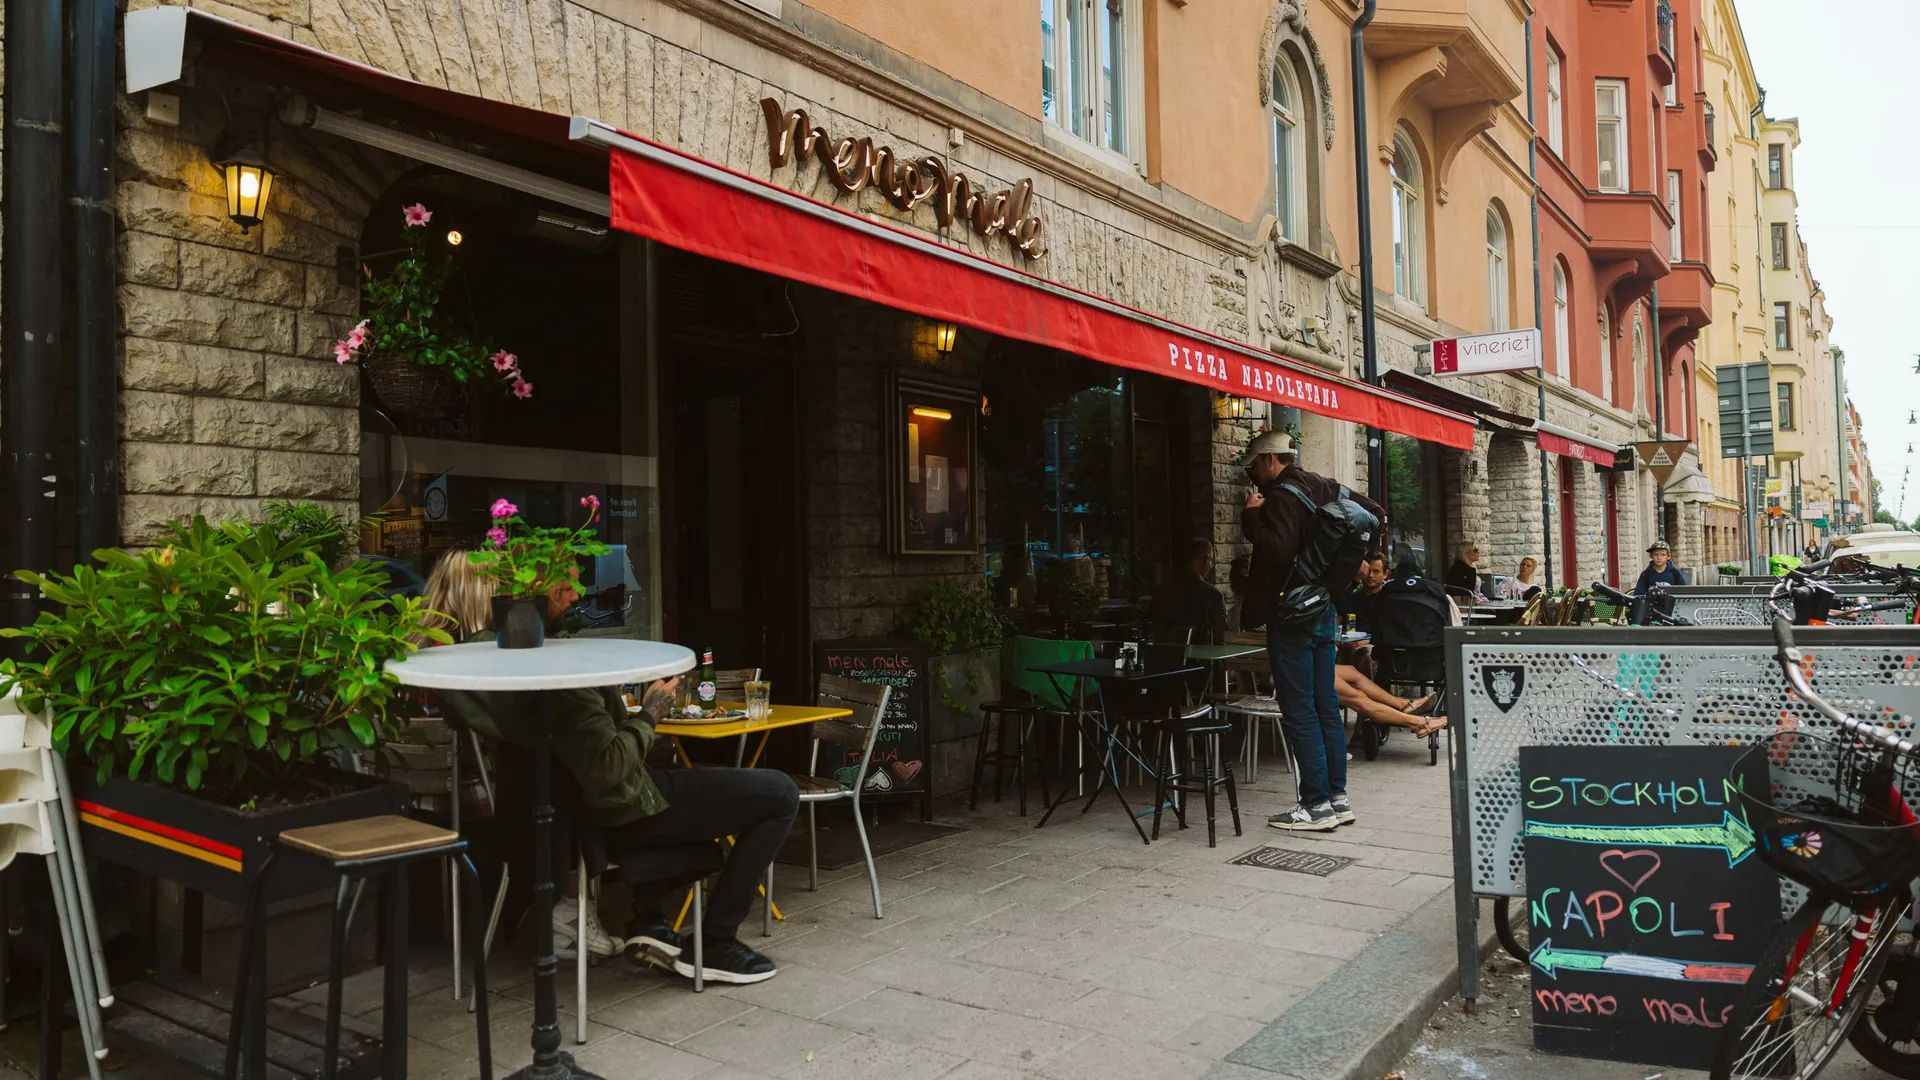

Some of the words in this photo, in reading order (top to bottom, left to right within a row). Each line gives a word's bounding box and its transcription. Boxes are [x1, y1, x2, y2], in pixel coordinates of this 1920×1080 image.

[1462, 335, 1531, 356] vineriet
[1168, 343, 1228, 381] PIZZA
[1242, 364, 1339, 409] NAPOLETANA
[872, 653, 912, 670] male
[1531, 887, 1735, 941] NAPOLI
[1536, 988, 1617, 1016] meno
